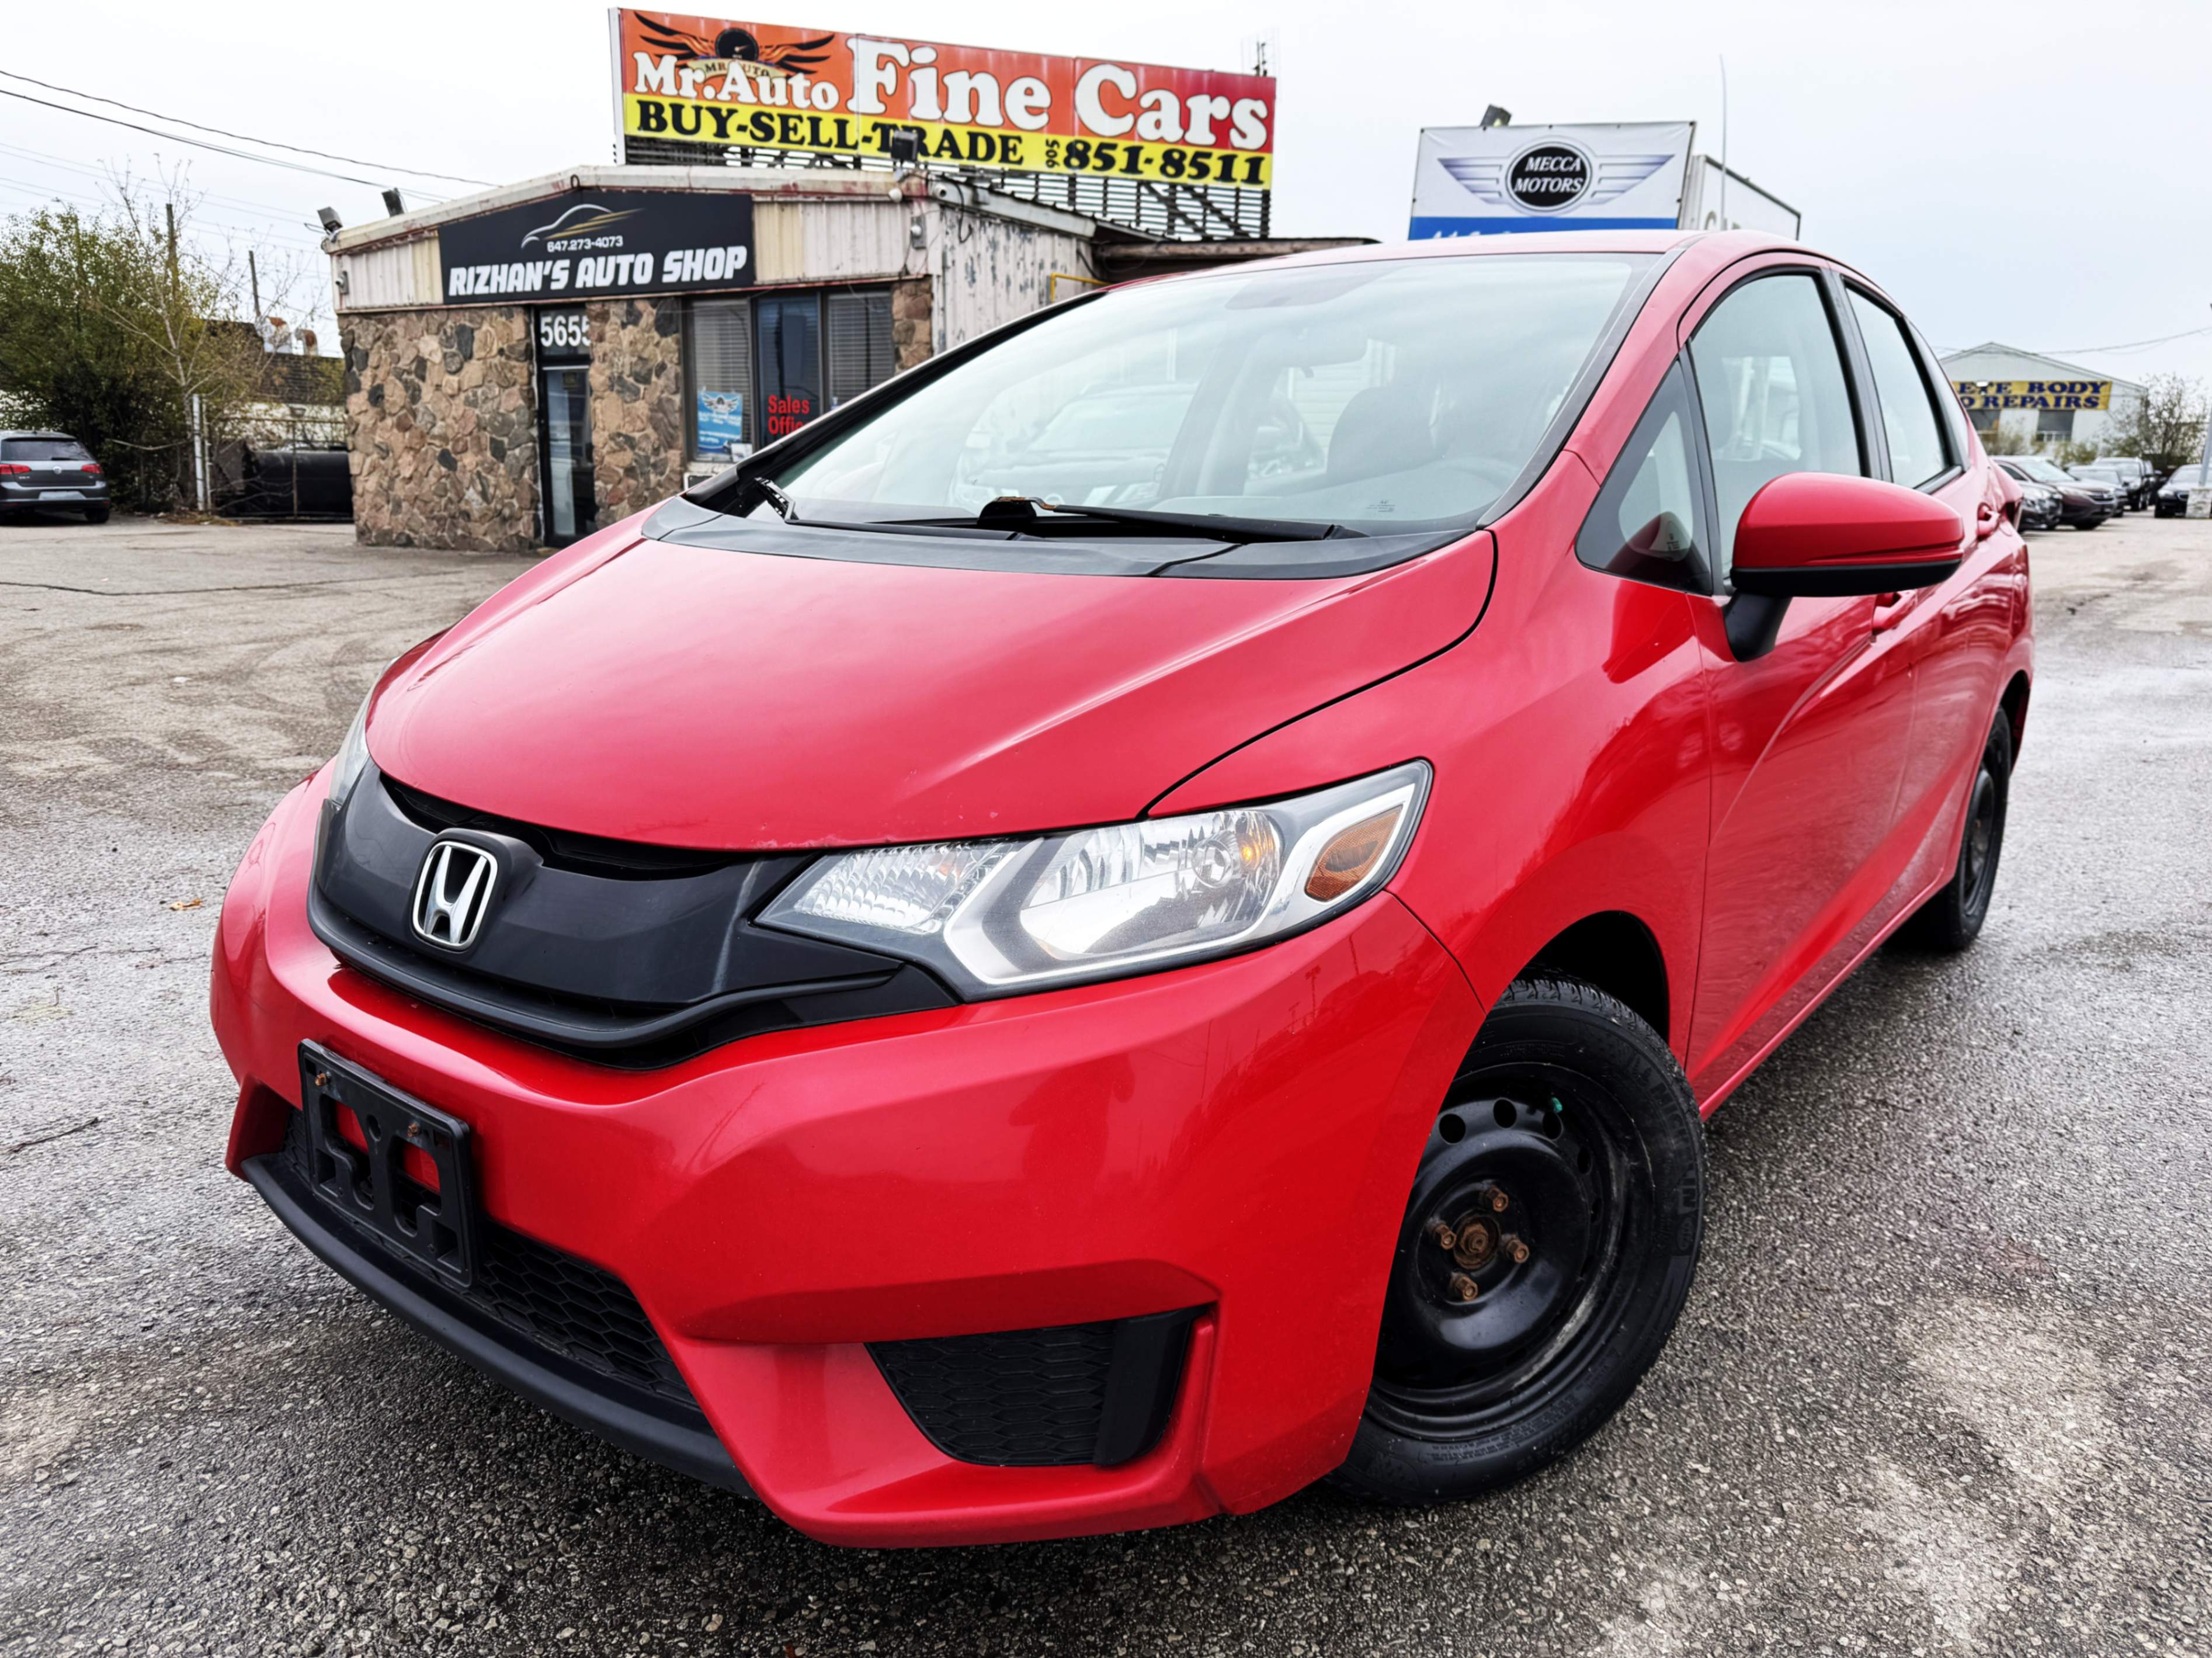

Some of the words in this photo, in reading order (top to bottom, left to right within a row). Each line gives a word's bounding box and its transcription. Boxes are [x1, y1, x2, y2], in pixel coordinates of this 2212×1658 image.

[846, 37, 1052, 131] Fine
[1075, 64, 1268, 150] Cars
[1045, 138, 1061, 168] 905
[1063, 139, 1265, 185] 851-8511
[1525, 156, 1581, 172] MECCA
[1513, 177, 1584, 193] MOTORS
[449, 259, 570, 297] RIZHAN'S
[575, 252, 654, 289] AUTO
[661, 245, 747, 283] SHOP
[2027, 381, 2107, 394] BODY
[768, 394, 810, 414] Sales
[1984, 396, 2100, 408] REPAIRS
